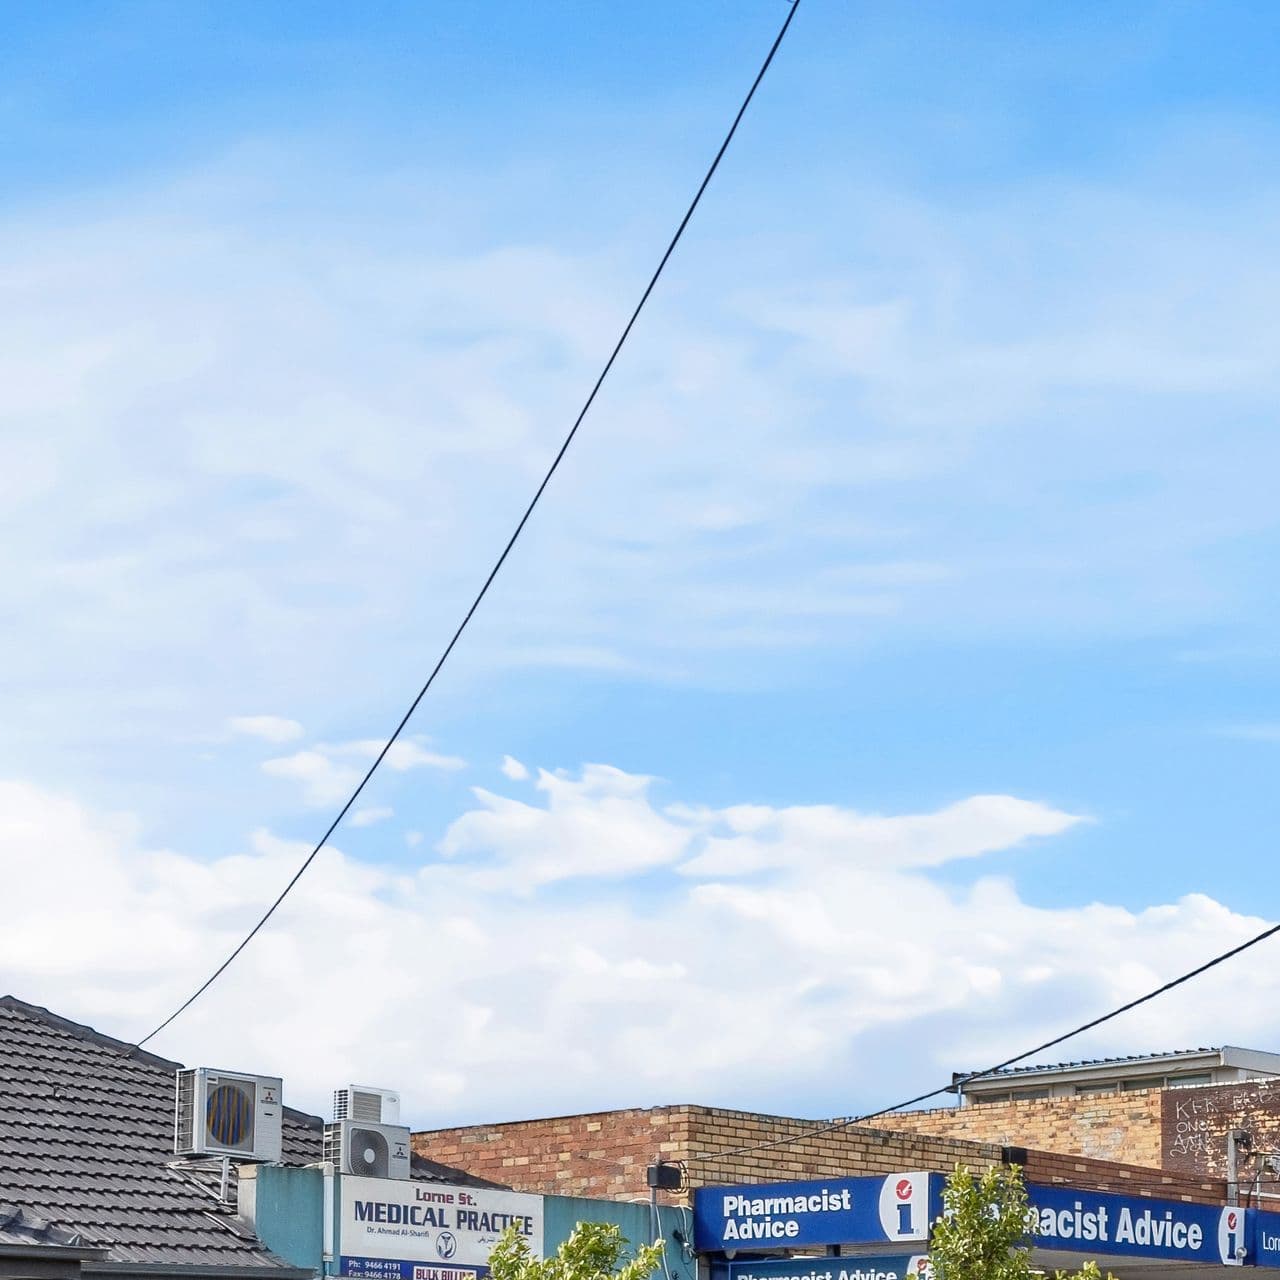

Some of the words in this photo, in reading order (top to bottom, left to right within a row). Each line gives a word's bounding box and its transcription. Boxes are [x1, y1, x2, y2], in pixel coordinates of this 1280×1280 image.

[416, 1188, 454, 1204] Lorne
[459, 1193, 477, 1206] St.
[723, 1189, 851, 1217] Pharmacist
[355, 1201, 450, 1228] MEDICAL
[367, 1226, 376, 1234] Dr.
[378, 1227, 400, 1236] Ahmad
[401, 1228, 429, 1238] Al-Sharifi
[723, 1217, 799, 1240] Advice
[1116, 1207, 1202, 1249] Advice
[349, 1260, 361, 1268] Ph:
[365, 1261, 383, 1270] 9466
[384, 1263, 401, 1271] 4191
[416, 1268, 439, 1280] BULK
[365, 1271, 383, 1279] 9466
[384, 1272, 401, 1280] 4178
